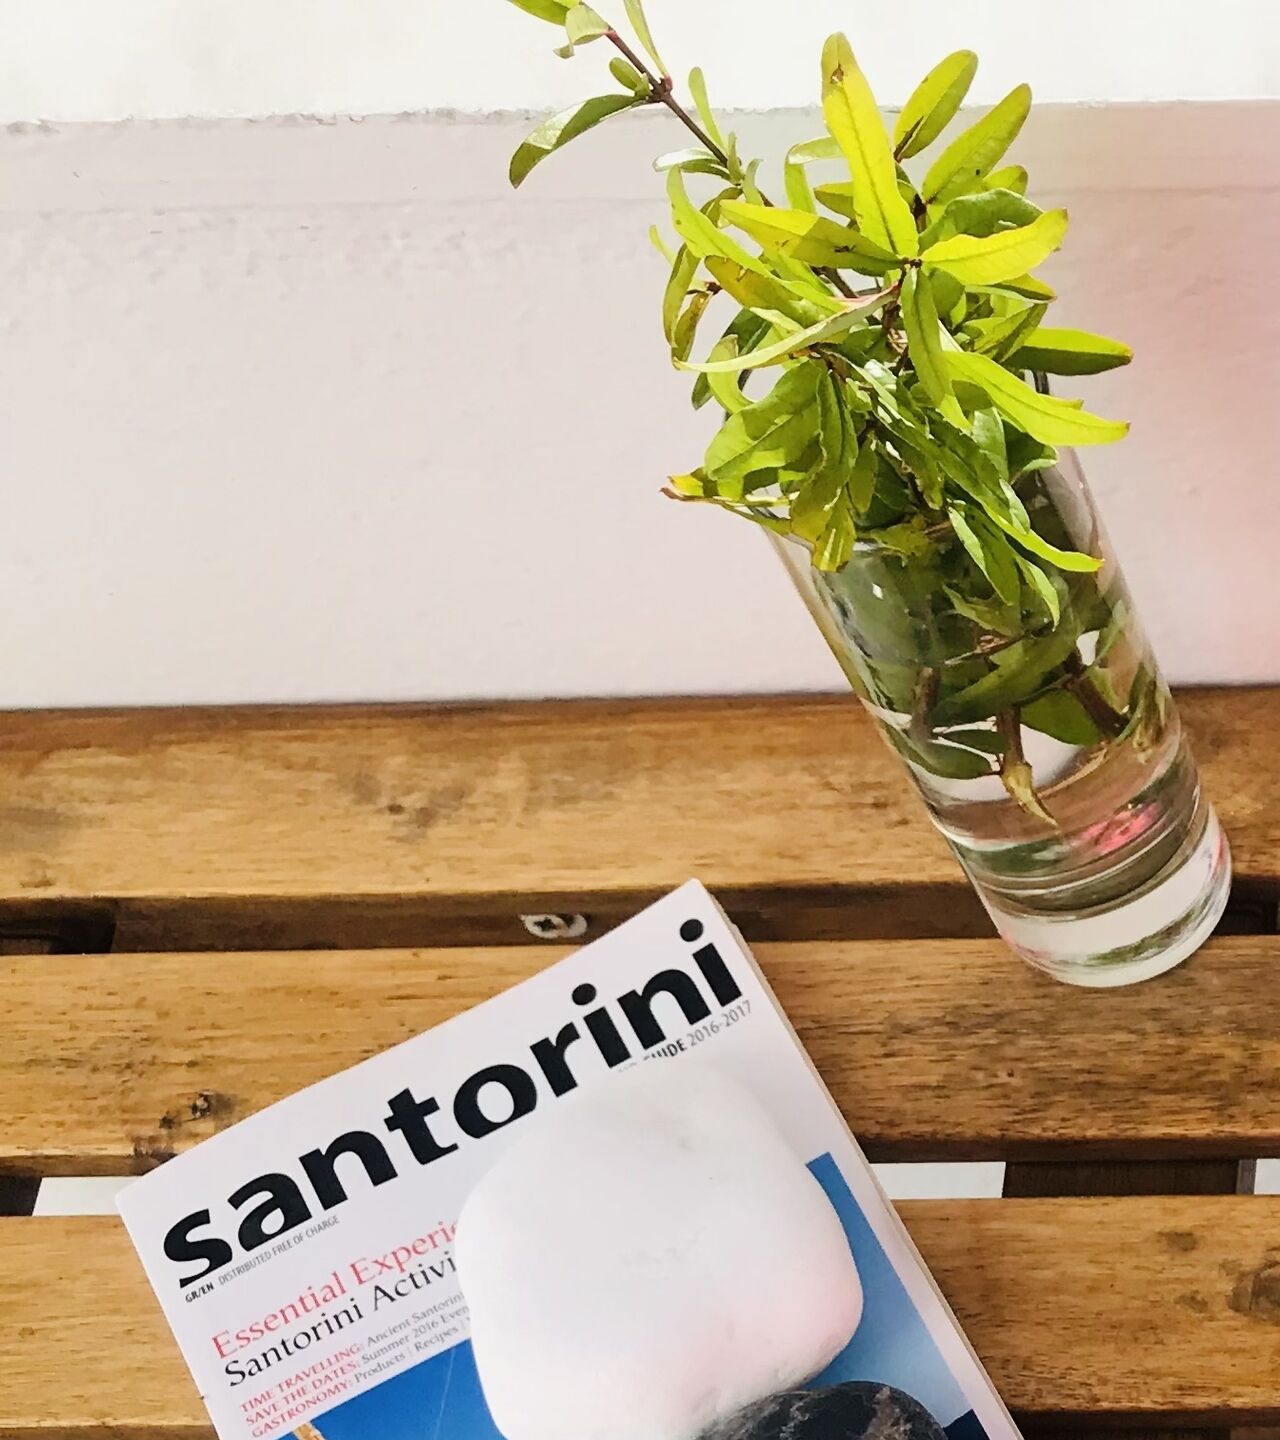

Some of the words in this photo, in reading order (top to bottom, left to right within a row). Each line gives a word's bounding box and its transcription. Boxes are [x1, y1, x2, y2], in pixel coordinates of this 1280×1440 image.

[686, 999, 751, 1047] 2016-2017
[163, 918, 742, 1288] santorini
[185, 1281, 214, 1303] GR/EN
[218, 1251, 272, 1285] DISTRIBUTED
[272, 1239, 292, 1256] FREE
[293, 1233, 305, 1245] OF
[305, 1215, 341, 1238] CHARGE
[211, 1271, 347, 1359] Essential
[225, 1297, 364, 1386] Santorini
[241, 1391, 273, 1414] TIME
[278, 1342, 364, 1394] TRAVELLING:
[367, 1317, 411, 1346] Ancient
[246, 1403, 280, 1425] SAVE
[283, 1387, 309, 1408] THE
[312, 1358, 360, 1390] DATES:
[361, 1332, 410, 1365] Summer
[413, 1319, 439, 1339] 2016
[251, 1377, 354, 1439] GASTRONOMY:
[353, 1351, 406, 1384] Products
[414, 1326, 460, 1353] Recipes
